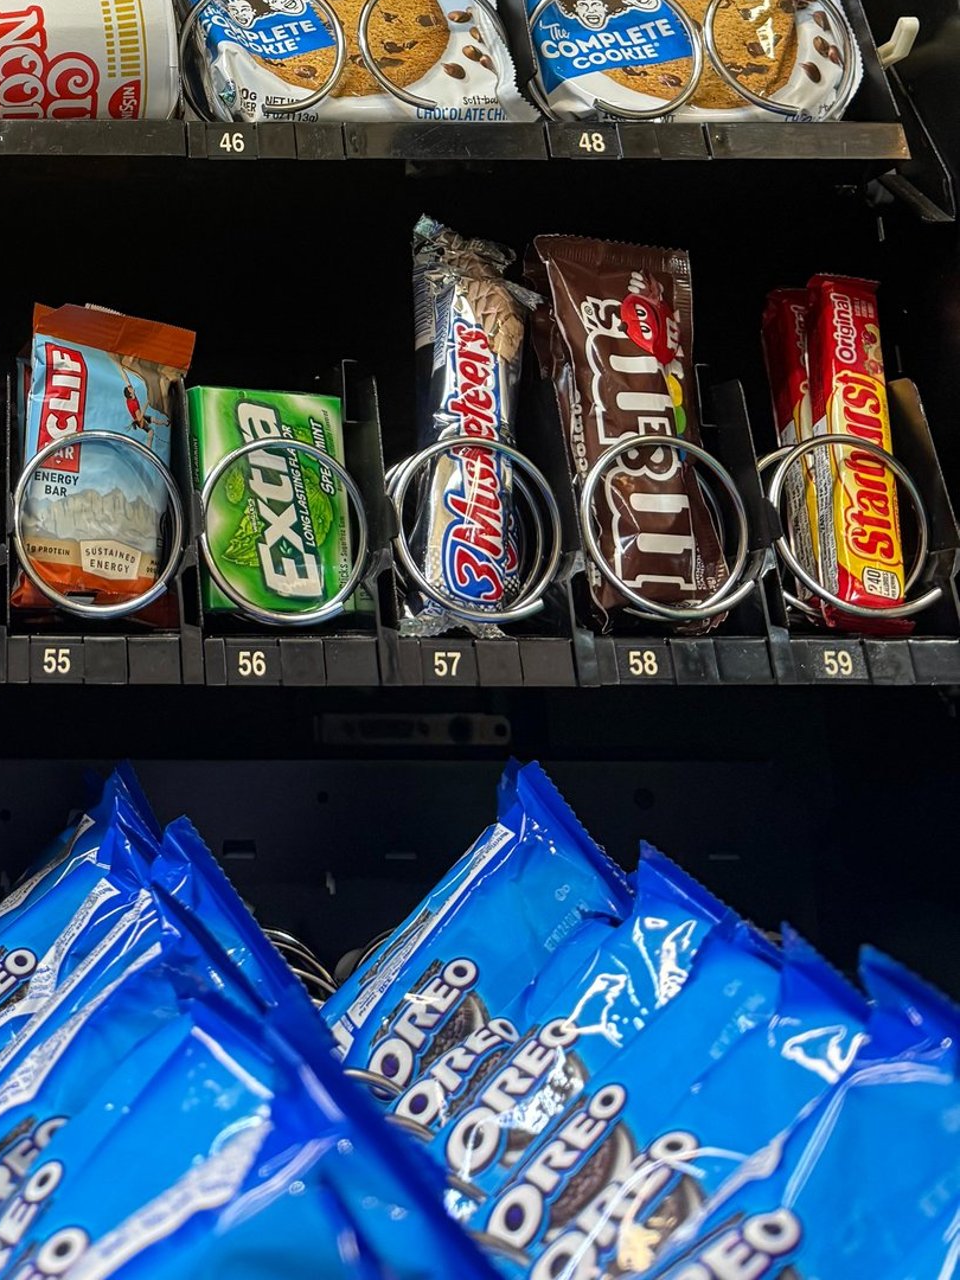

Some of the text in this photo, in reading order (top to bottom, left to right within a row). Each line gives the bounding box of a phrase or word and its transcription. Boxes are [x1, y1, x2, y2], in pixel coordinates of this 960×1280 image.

[540, 18, 676, 58] COMPLETE
[547, 22, 570, 42] The
[572, 46, 658, 70] COOKIE
[416, 107, 486, 121] CHOCOLATE
[219, 132, 246, 152] 46
[578, 133, 606, 152] 48
[45, 350, 82, 438] CLIF
[34, 471, 79, 486] ENERGY
[838, 370, 895, 567] Starburst
[44, 484, 68, 498] BAR
[295, 476, 316, 547] LONG LASTING
[37, 546, 70, 557] PROTEIN
[84, 547, 137, 564] SUSTAINED
[89, 558, 131, 575] ENERGY
[457, 547, 502, 602] 3
[866, 567, 880, 596] 240
[42, 648, 71, 674] 55
[238, 651, 266, 676] 56
[434, 651, 461, 676] 57
[628, 650, 658, 676] 58
[823, 651, 853, 675] 59
[369, 956, 478, 1098] OREO
[395, 1017, 520, 1126] OREO
[446, 1014, 579, 1175] OREO
[487, 1083, 628, 1249] OREO
